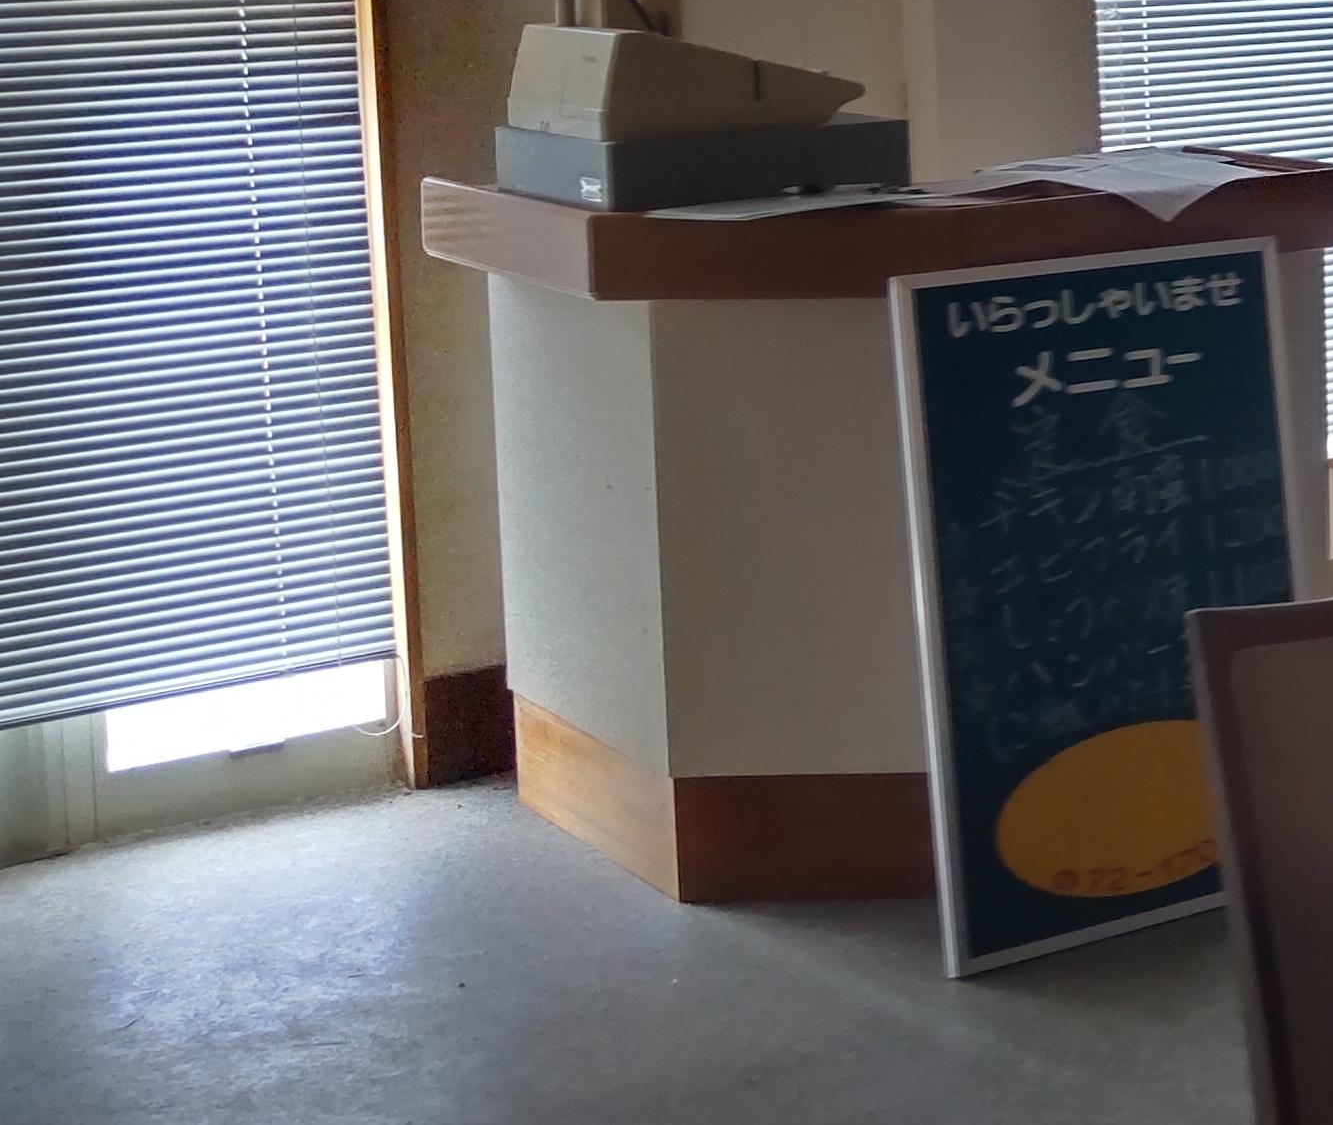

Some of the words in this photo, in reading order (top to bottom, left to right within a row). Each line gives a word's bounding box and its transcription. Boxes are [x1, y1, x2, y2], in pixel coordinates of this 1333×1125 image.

[946, 271, 1244, 338] いらっしゃいませ
[1010, 347, 1203, 408] メニュー
